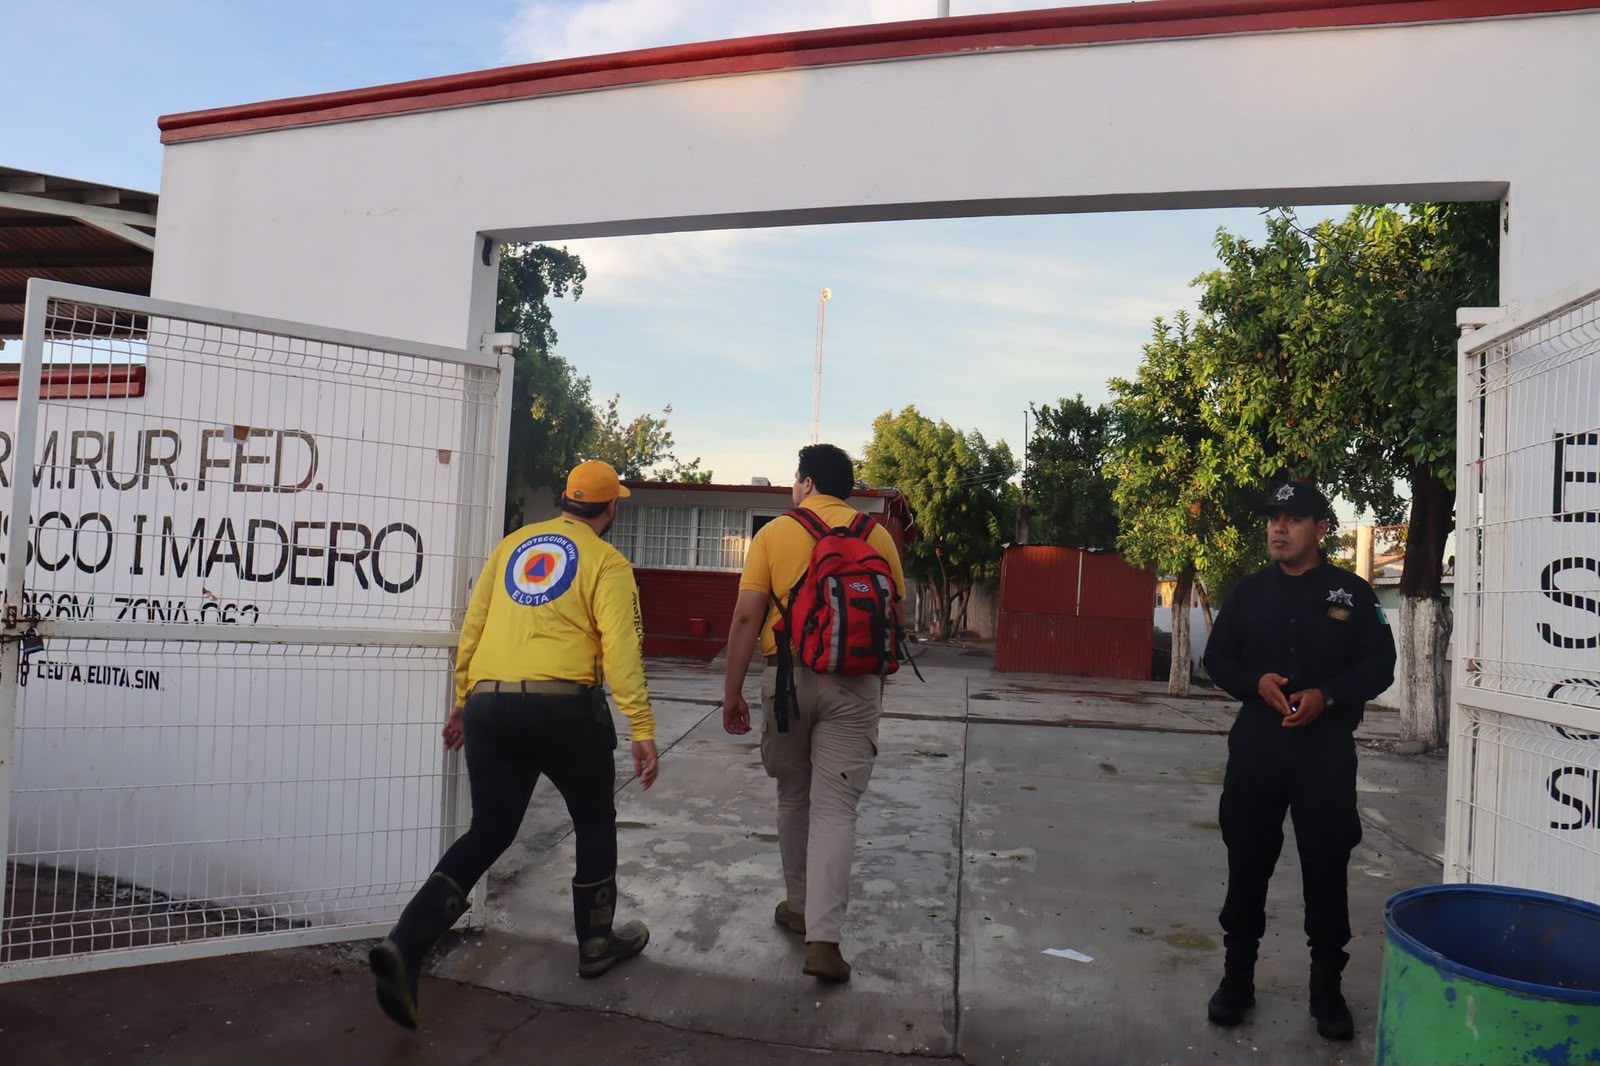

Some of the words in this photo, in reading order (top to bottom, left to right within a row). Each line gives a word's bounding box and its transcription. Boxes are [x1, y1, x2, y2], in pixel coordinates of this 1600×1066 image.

[130, 514, 148, 576] I
[160, 515, 425, 595] MADERO
[565, 543, 576, 561] CIVIL
[511, 589, 549, 605] ELOTA
